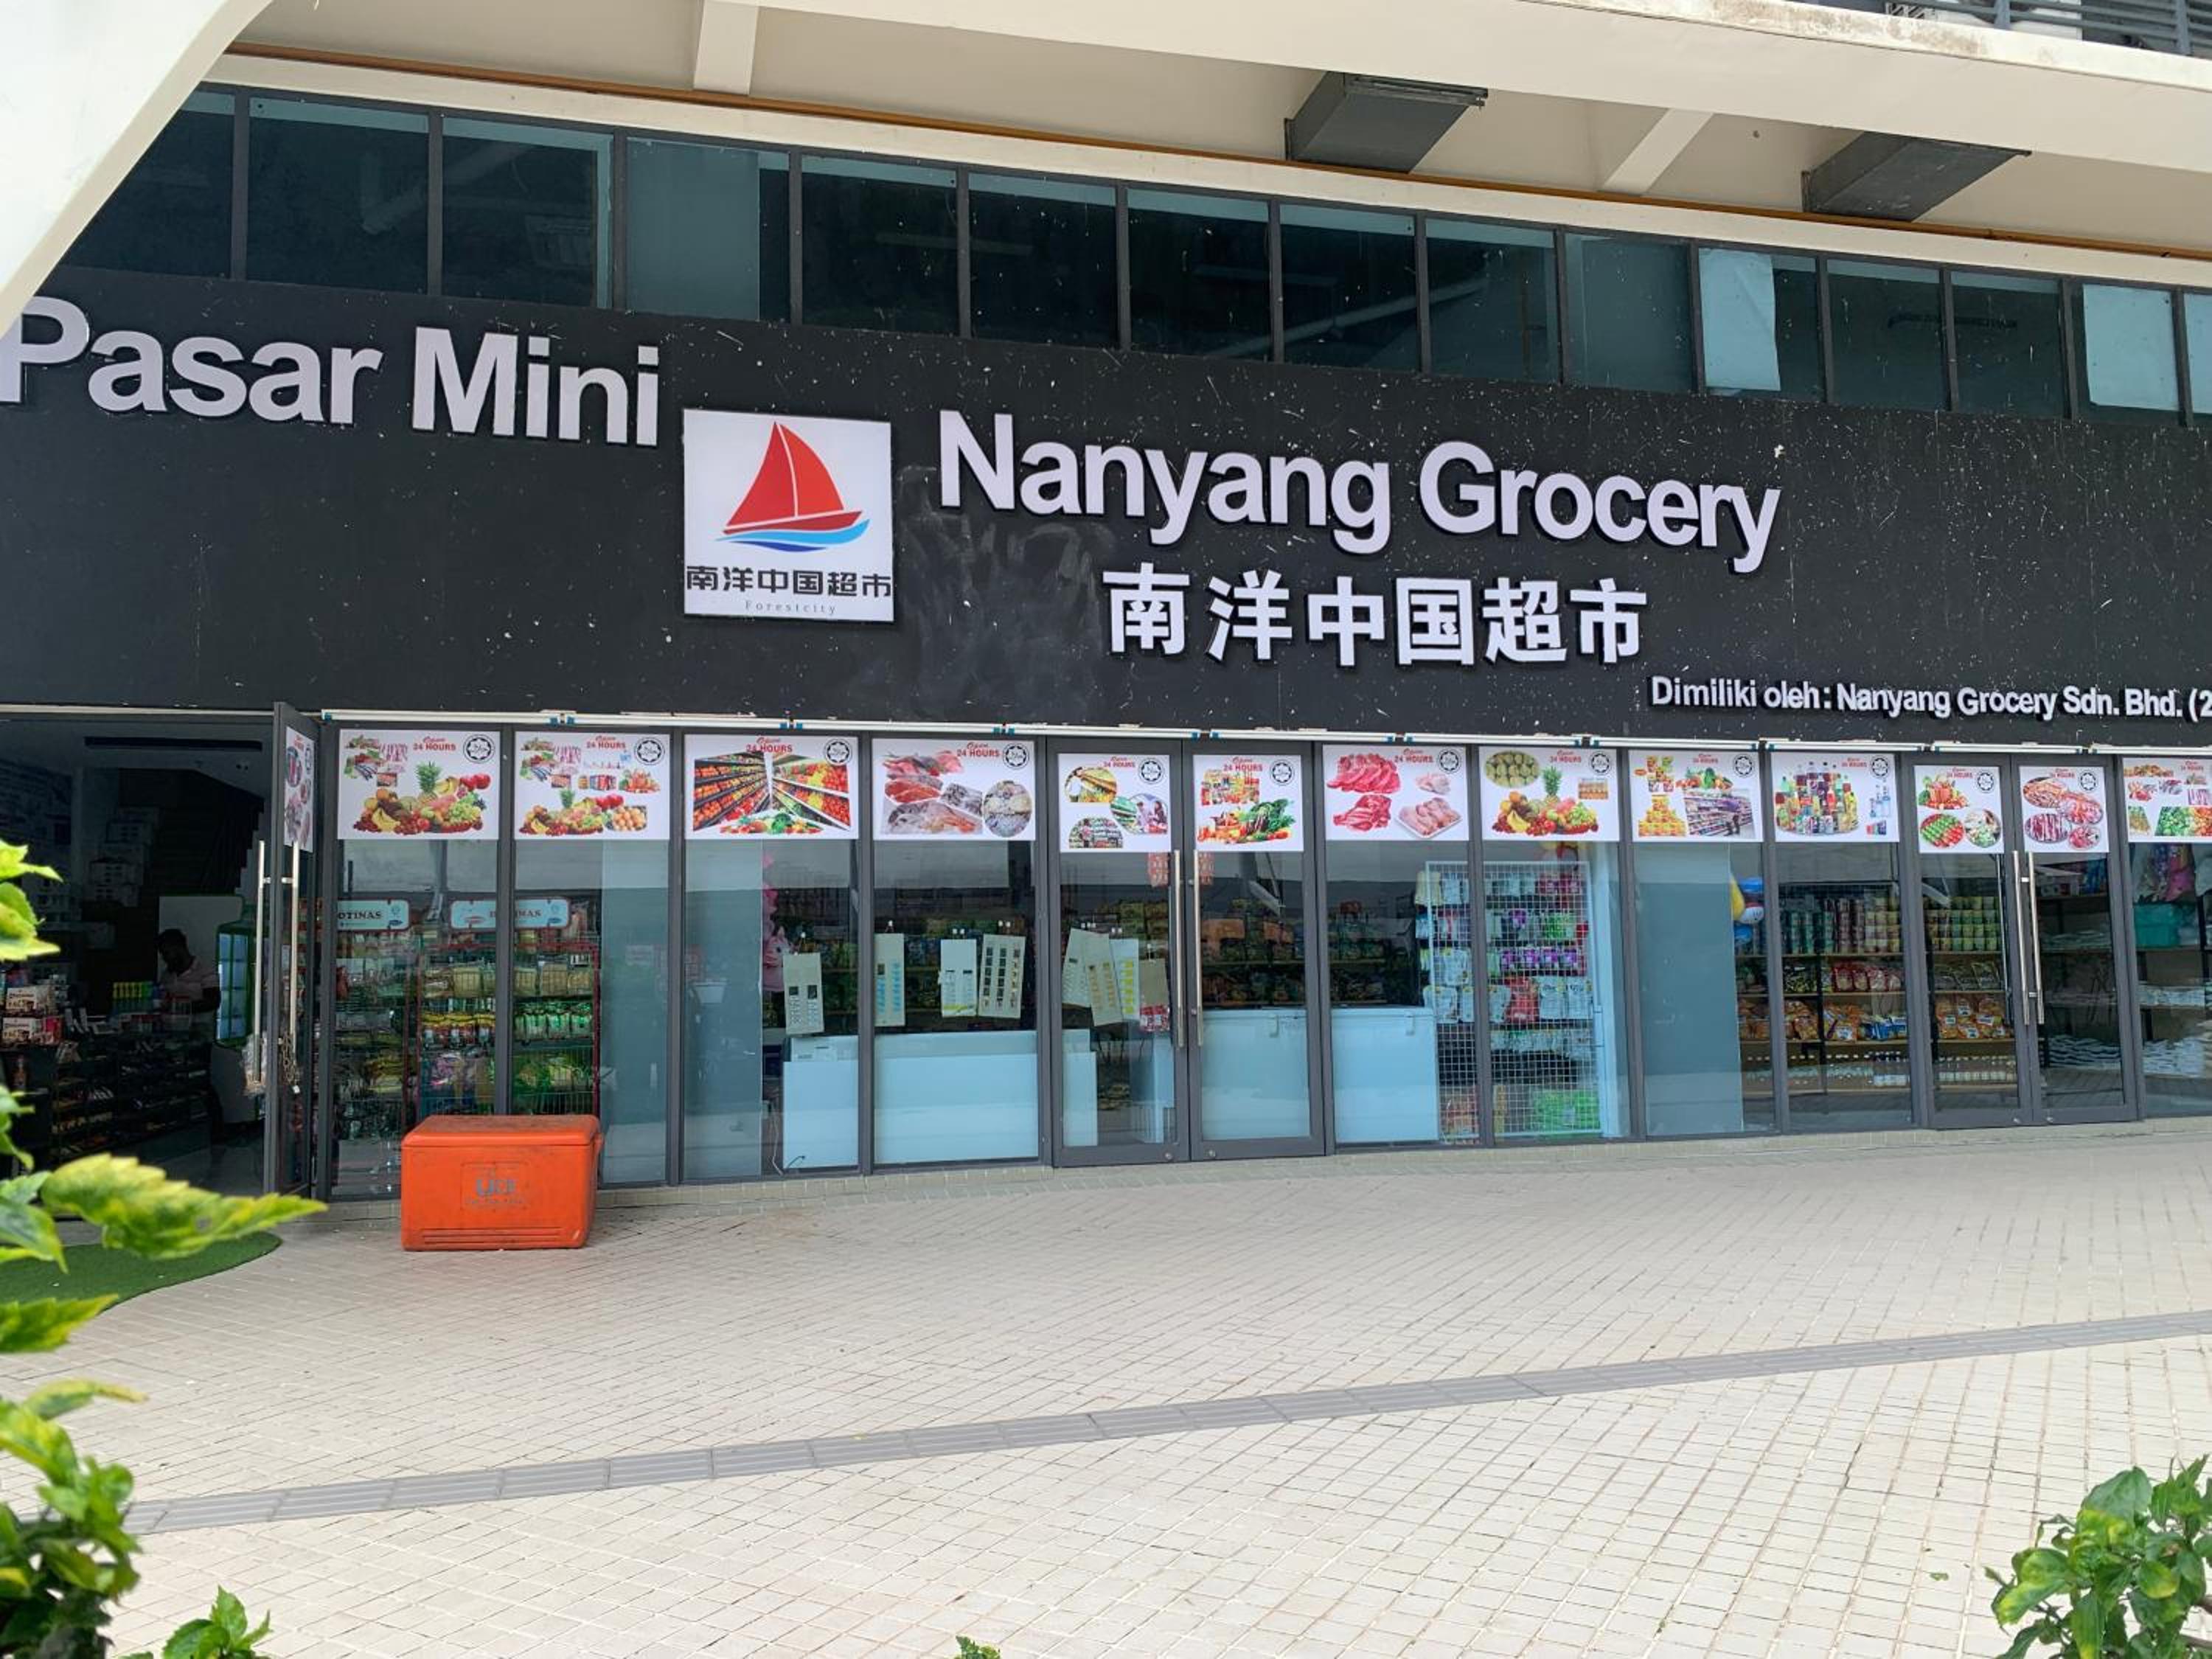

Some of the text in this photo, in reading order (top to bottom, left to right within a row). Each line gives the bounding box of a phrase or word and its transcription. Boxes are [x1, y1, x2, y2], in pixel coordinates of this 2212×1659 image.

[0, 295, 658, 446] Pasar Mini
[940, 410, 1781, 574] Nanyang Grocery
[686, 565, 891, 598] 南洋中国超市
[1102, 562, 1647, 667] 南洋中国超市
[1652, 676, 1757, 707] Dimiliki
[1764, 681, 1832, 709] oleh:
[1837, 684, 1951, 718] Nanyang
[1958, 686, 2058, 720] Grocery
[2063, 685, 2120, 716] Sdn.
[2125, 688, 2183, 717] Bhd.
[759, 744, 793, 753] HOURS
[970, 749, 1000, 757] HOURS
[1405, 755, 1433, 763] HOURS
[338, 911, 382, 919] OTINAS
